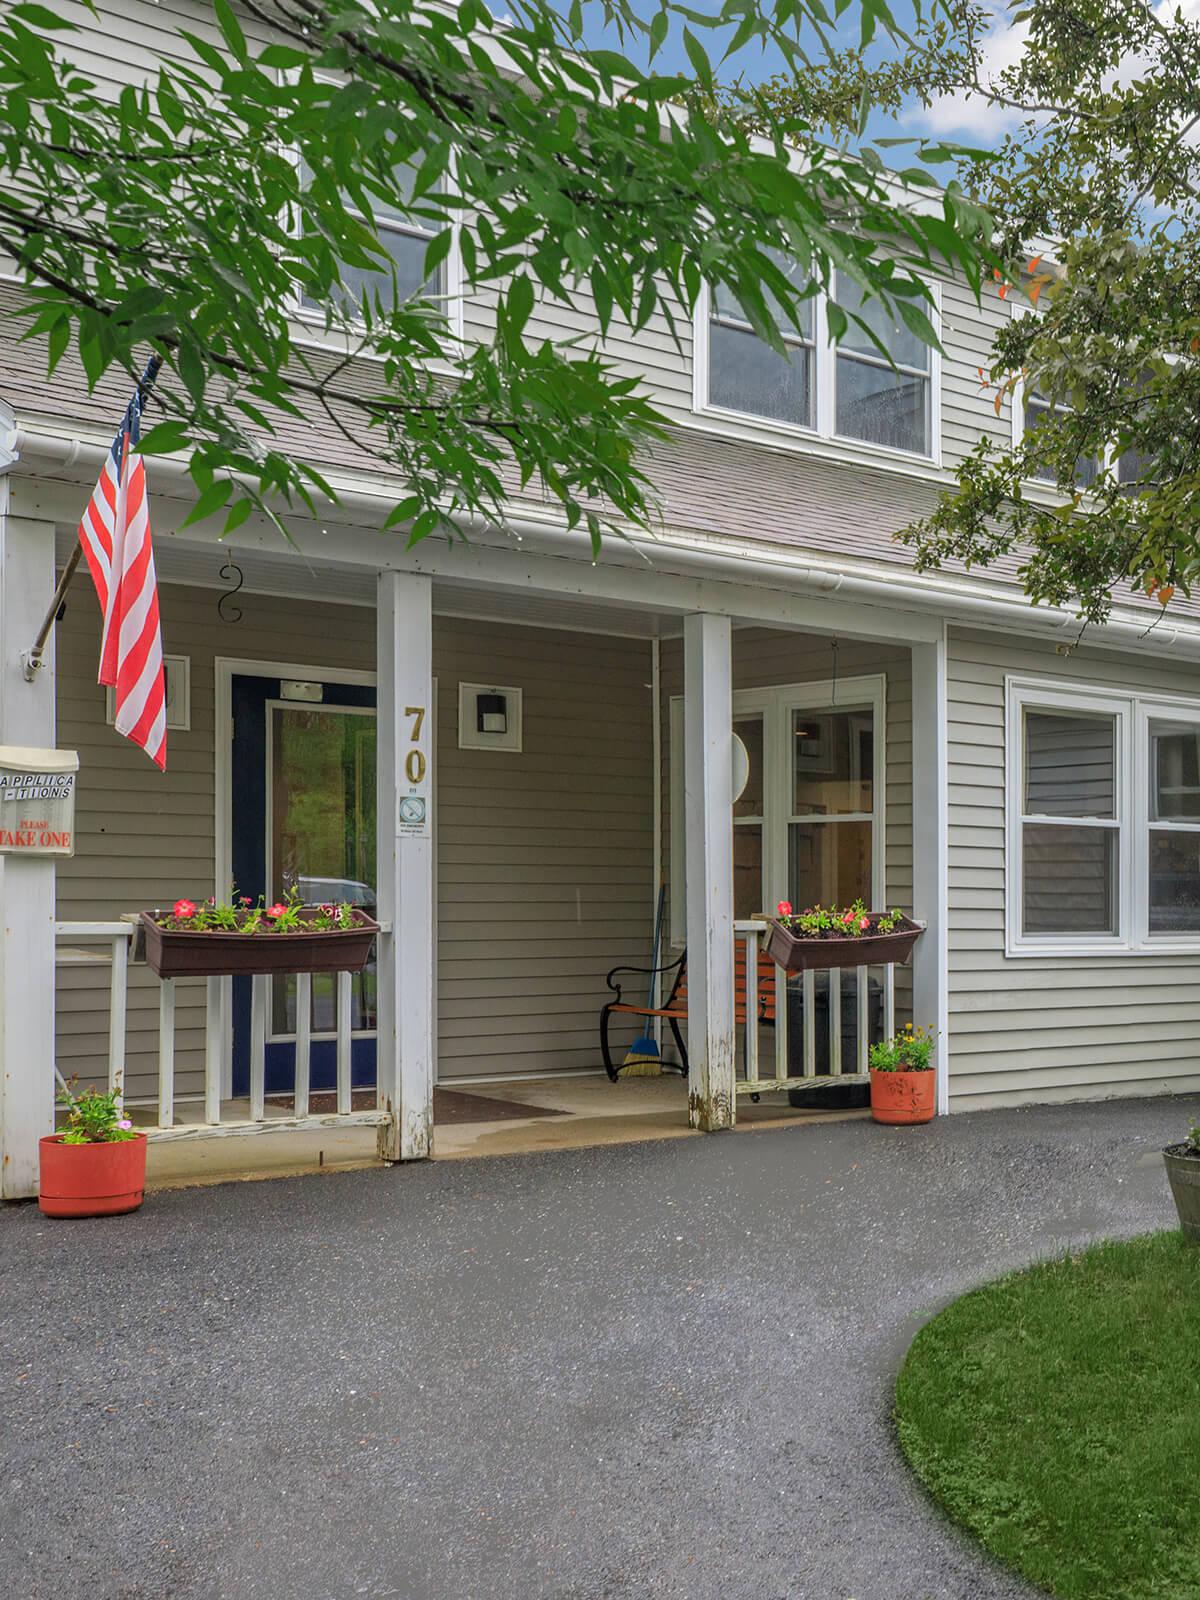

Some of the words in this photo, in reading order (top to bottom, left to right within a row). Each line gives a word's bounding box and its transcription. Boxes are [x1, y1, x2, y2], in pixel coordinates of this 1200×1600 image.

[405, 706, 426, 784] 70
[0, 775, 73, 786] APPLICA
[7, 787, 70, 798] -TIONS
[20, 820, 48, 829] PLEASE
[0, 830, 36, 847] TAKE
[40, 831, 70, 847] ONE
